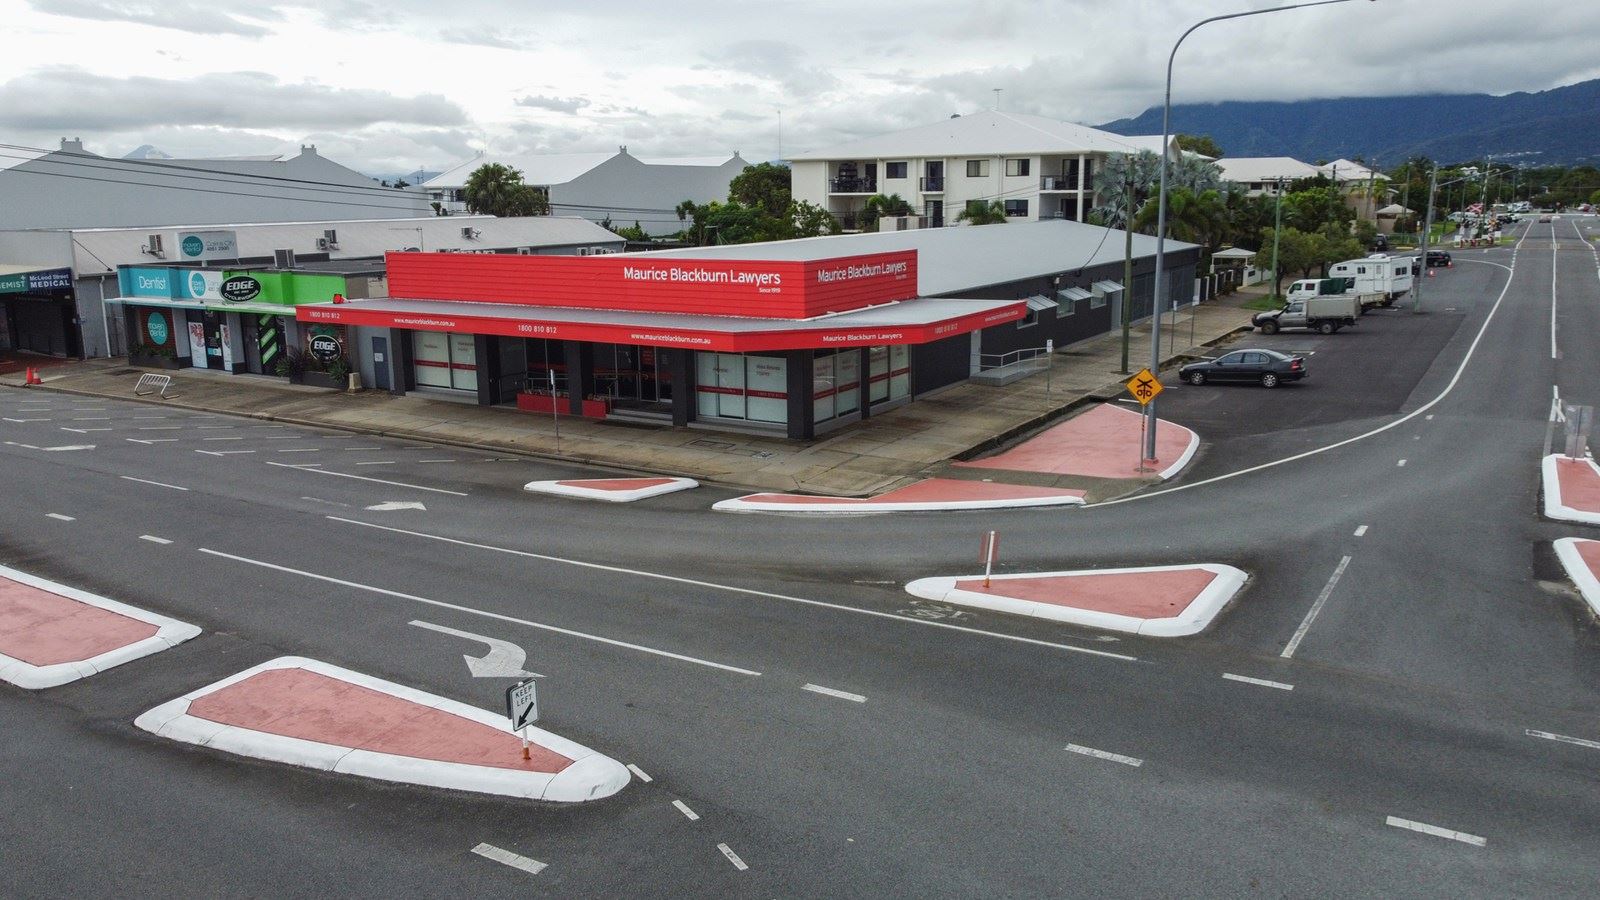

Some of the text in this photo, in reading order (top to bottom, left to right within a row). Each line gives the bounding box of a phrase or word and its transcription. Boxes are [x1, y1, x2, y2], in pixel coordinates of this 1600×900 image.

[623, 266, 781, 287] Maurice Blackburn Lawyers
[817, 261, 907, 282] Maurice Blackburn Lawyers
[0, 280, 26, 289] EMIST
[30, 280, 70, 288] MEDICAL
[138, 275, 166, 290] Dentist
[226, 280, 255, 291] EDGE
[393, 318, 456, 327] www.mauriceblackburn.com.au
[518, 324, 558, 334] 1800 810 812
[630, 333, 712, 345] www.mauriceblackburn.com.au
[847, 333, 877, 341] Blackburn
[877, 332, 903, 341] Lawyers
[314, 340, 336, 351] EDGE
[515, 685, 533, 698] KEEP
[516, 693, 532, 707] LEFT
